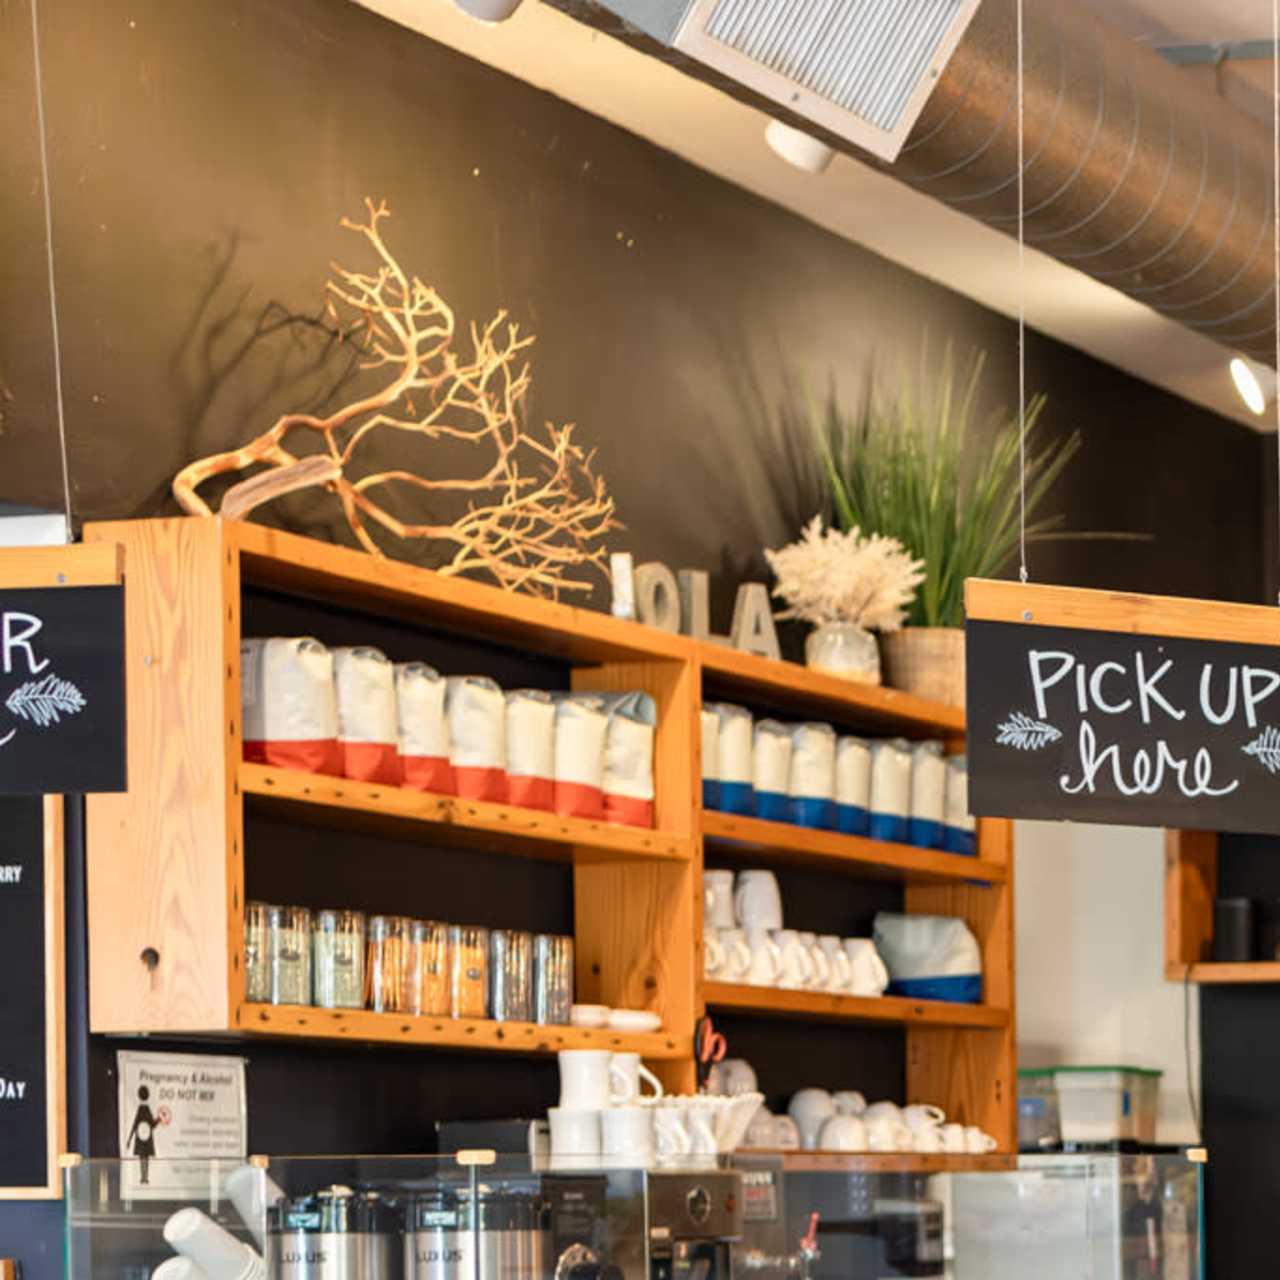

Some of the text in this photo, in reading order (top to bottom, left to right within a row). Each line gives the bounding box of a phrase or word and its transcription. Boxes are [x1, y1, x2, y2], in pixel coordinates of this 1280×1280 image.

[1029, 650, 1186, 724] PICK
[1059, 719, 1239, 797] here
[159, 1087, 175, 1101] DO
[177, 1088, 197, 1101] NOT
